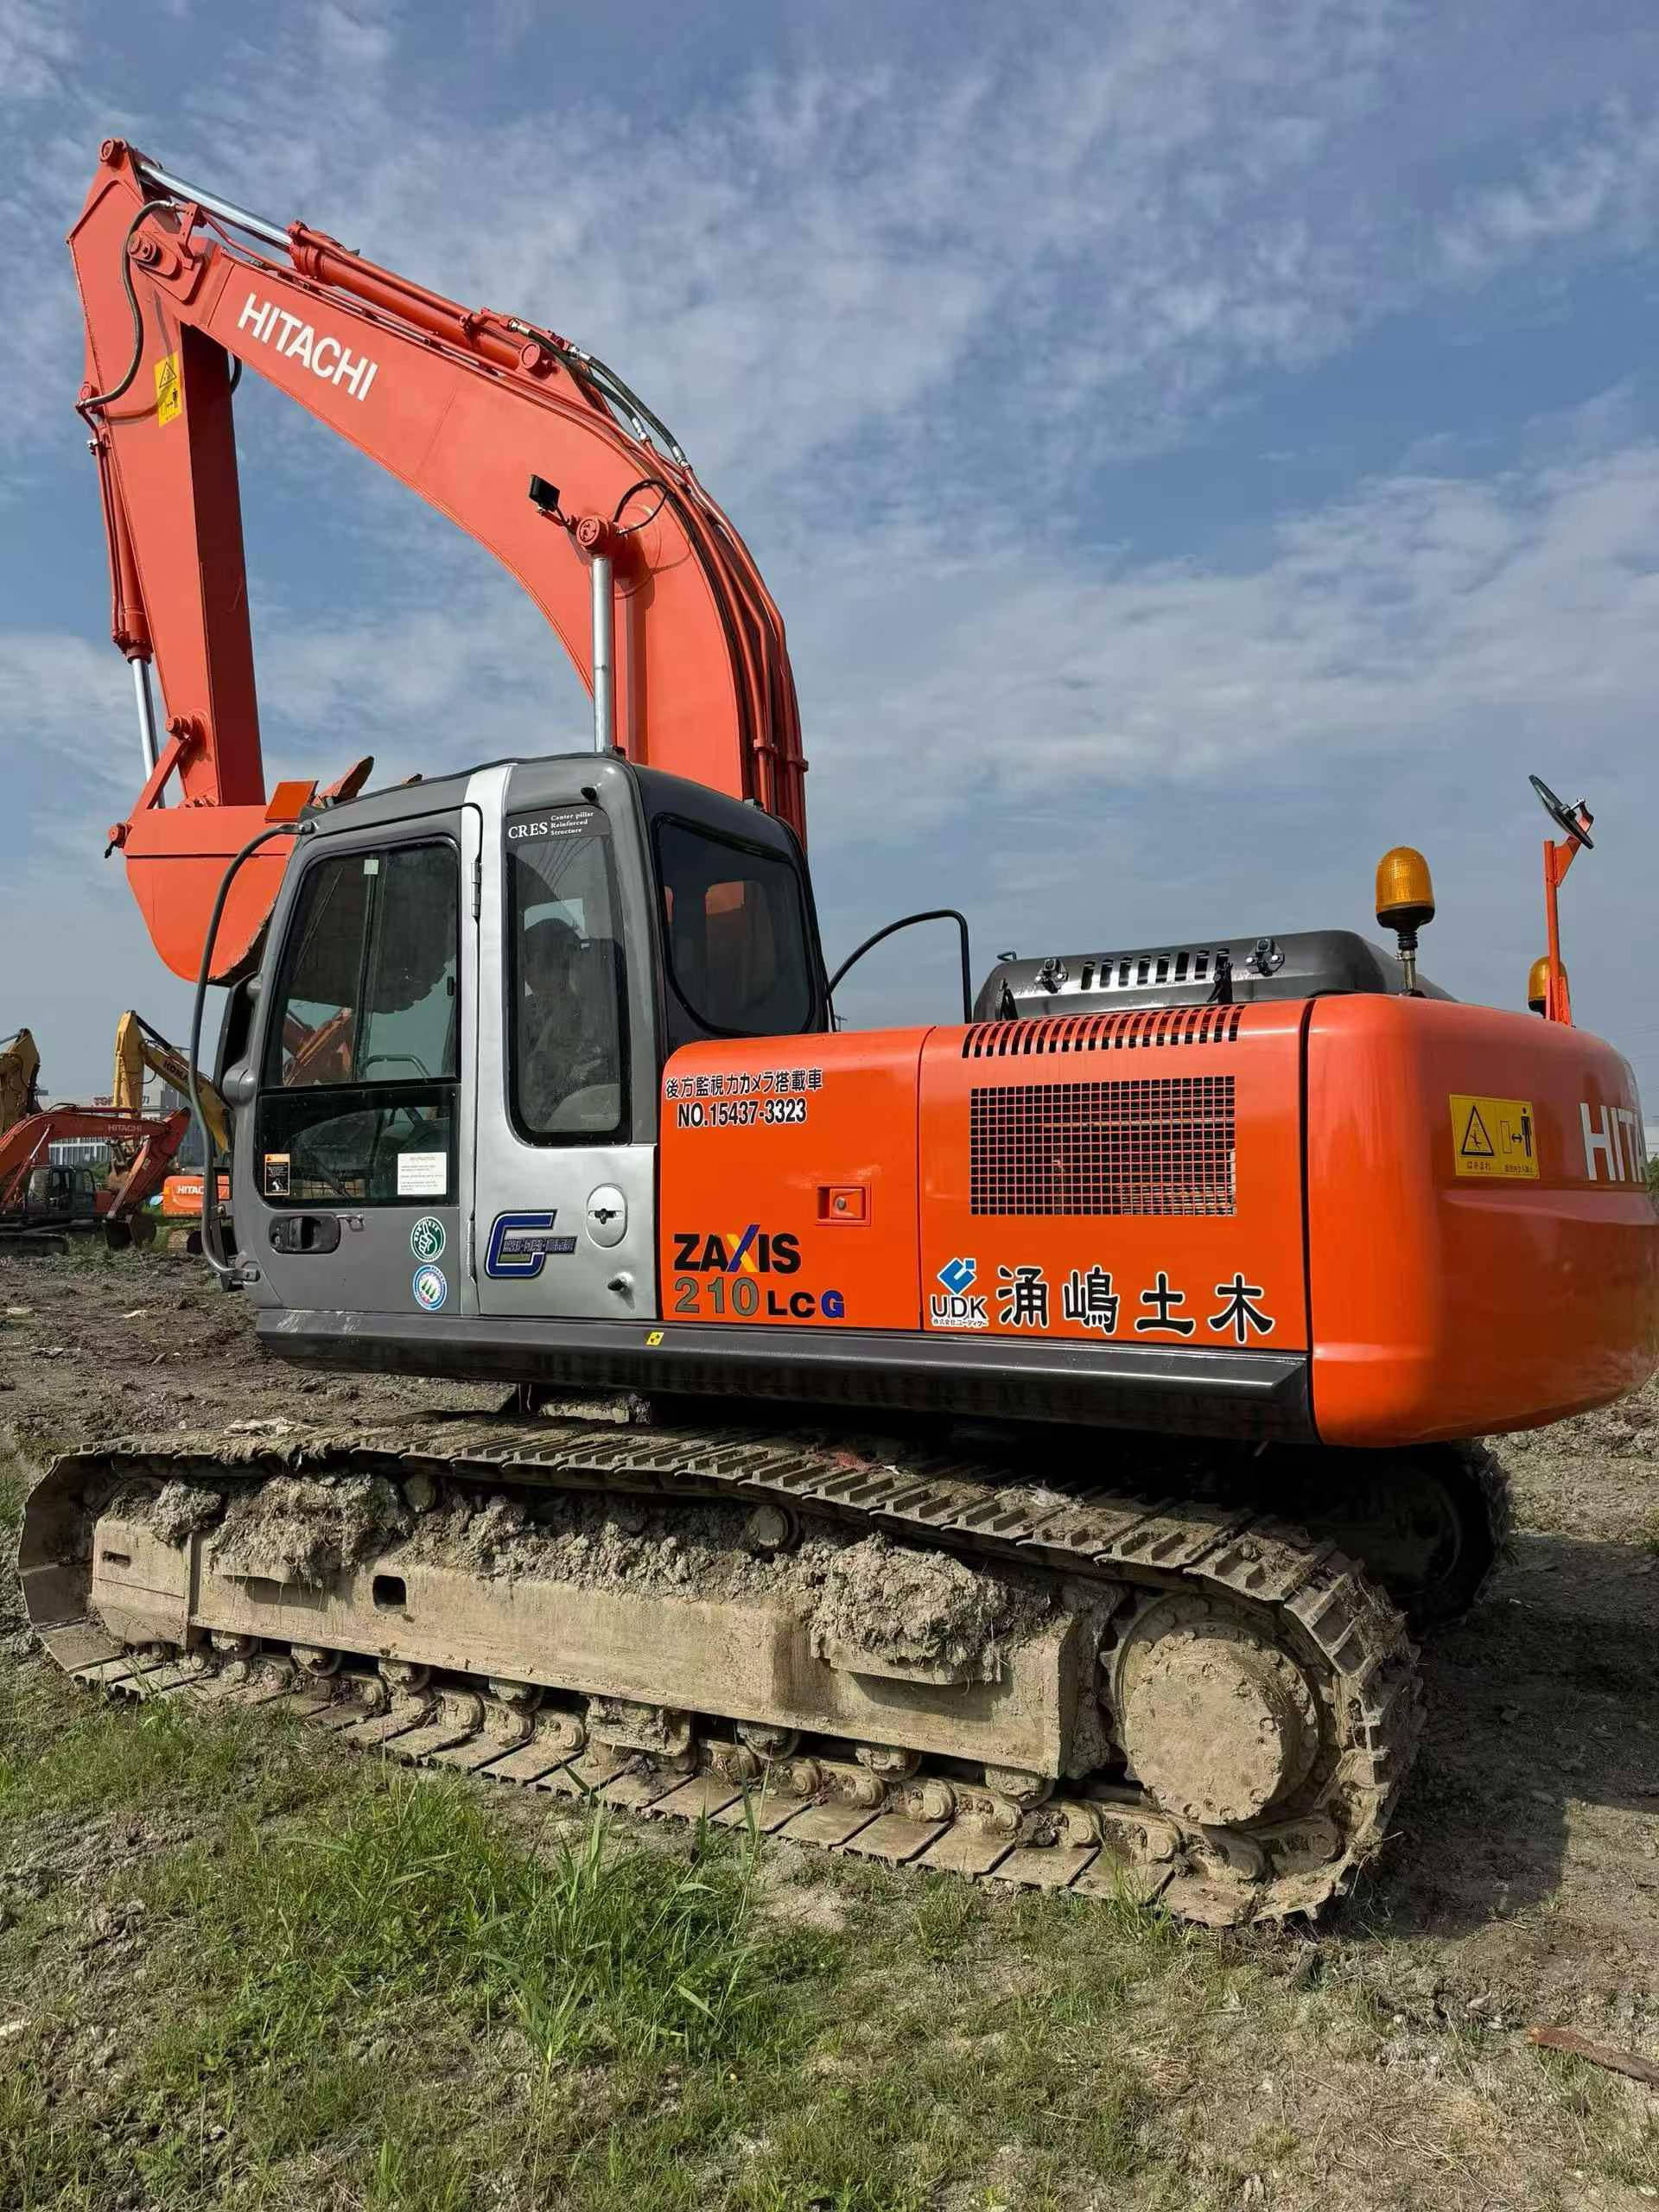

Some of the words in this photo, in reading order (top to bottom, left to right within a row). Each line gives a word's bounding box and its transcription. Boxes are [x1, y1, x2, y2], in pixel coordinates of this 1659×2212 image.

[238, 292, 378, 401] HITACHI
[508, 822, 548, 839] CRES
[550, 819, 588, 829] Reinforced
[678, 1099, 806, 1127] NO.15437-3323
[674, 1224, 801, 1273] ZAXIS
[932, 1296, 986, 1319] UDK
